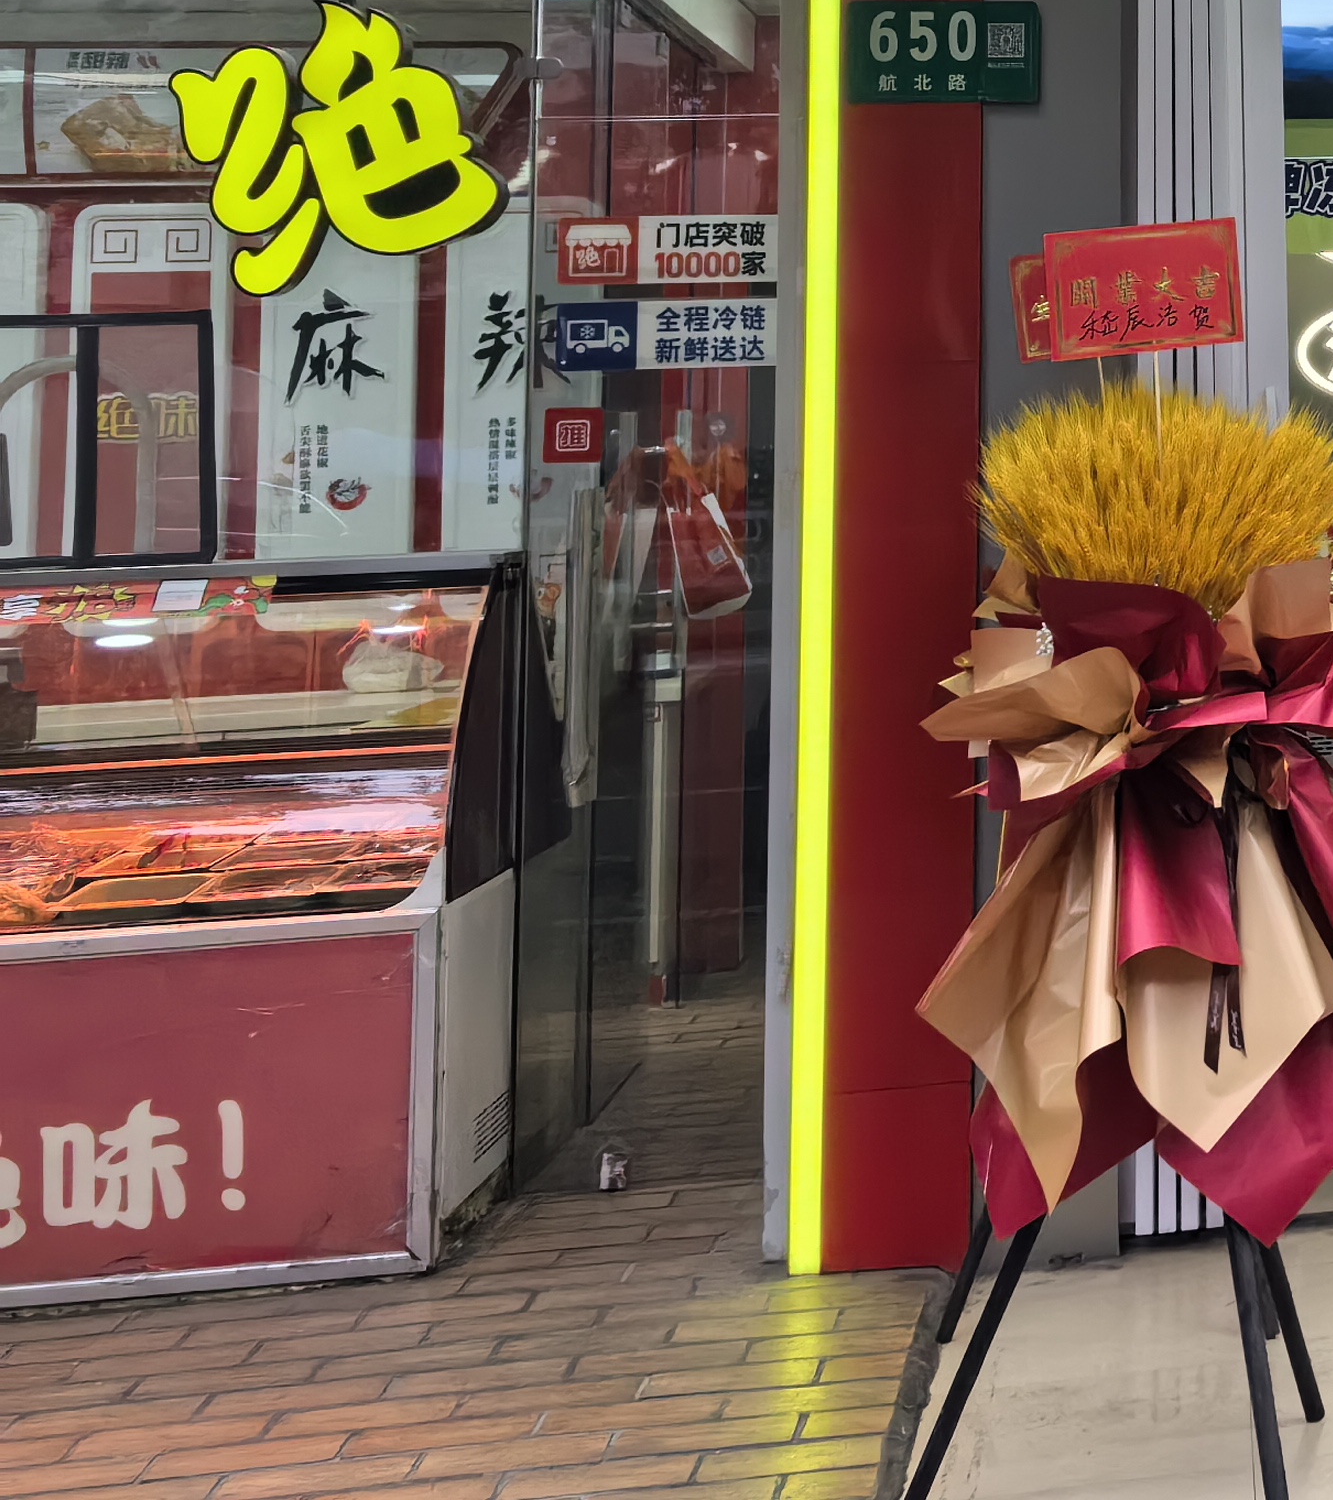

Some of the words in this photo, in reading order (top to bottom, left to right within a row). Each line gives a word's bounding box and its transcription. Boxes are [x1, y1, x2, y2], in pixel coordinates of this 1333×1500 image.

[869, 10, 977, 62] 650
[878, 73, 966, 91] 航北路
[168, 0, 505, 297] 绝
[656, 222, 767, 248] 门店突破
[655, 250, 767, 278] 10000家
[655, 304, 767, 333] 全程冷链
[285, 288, 385, 405] 麻
[655, 335, 766, 363] 新鲜送达
[560, 425, 587, 448] 推
